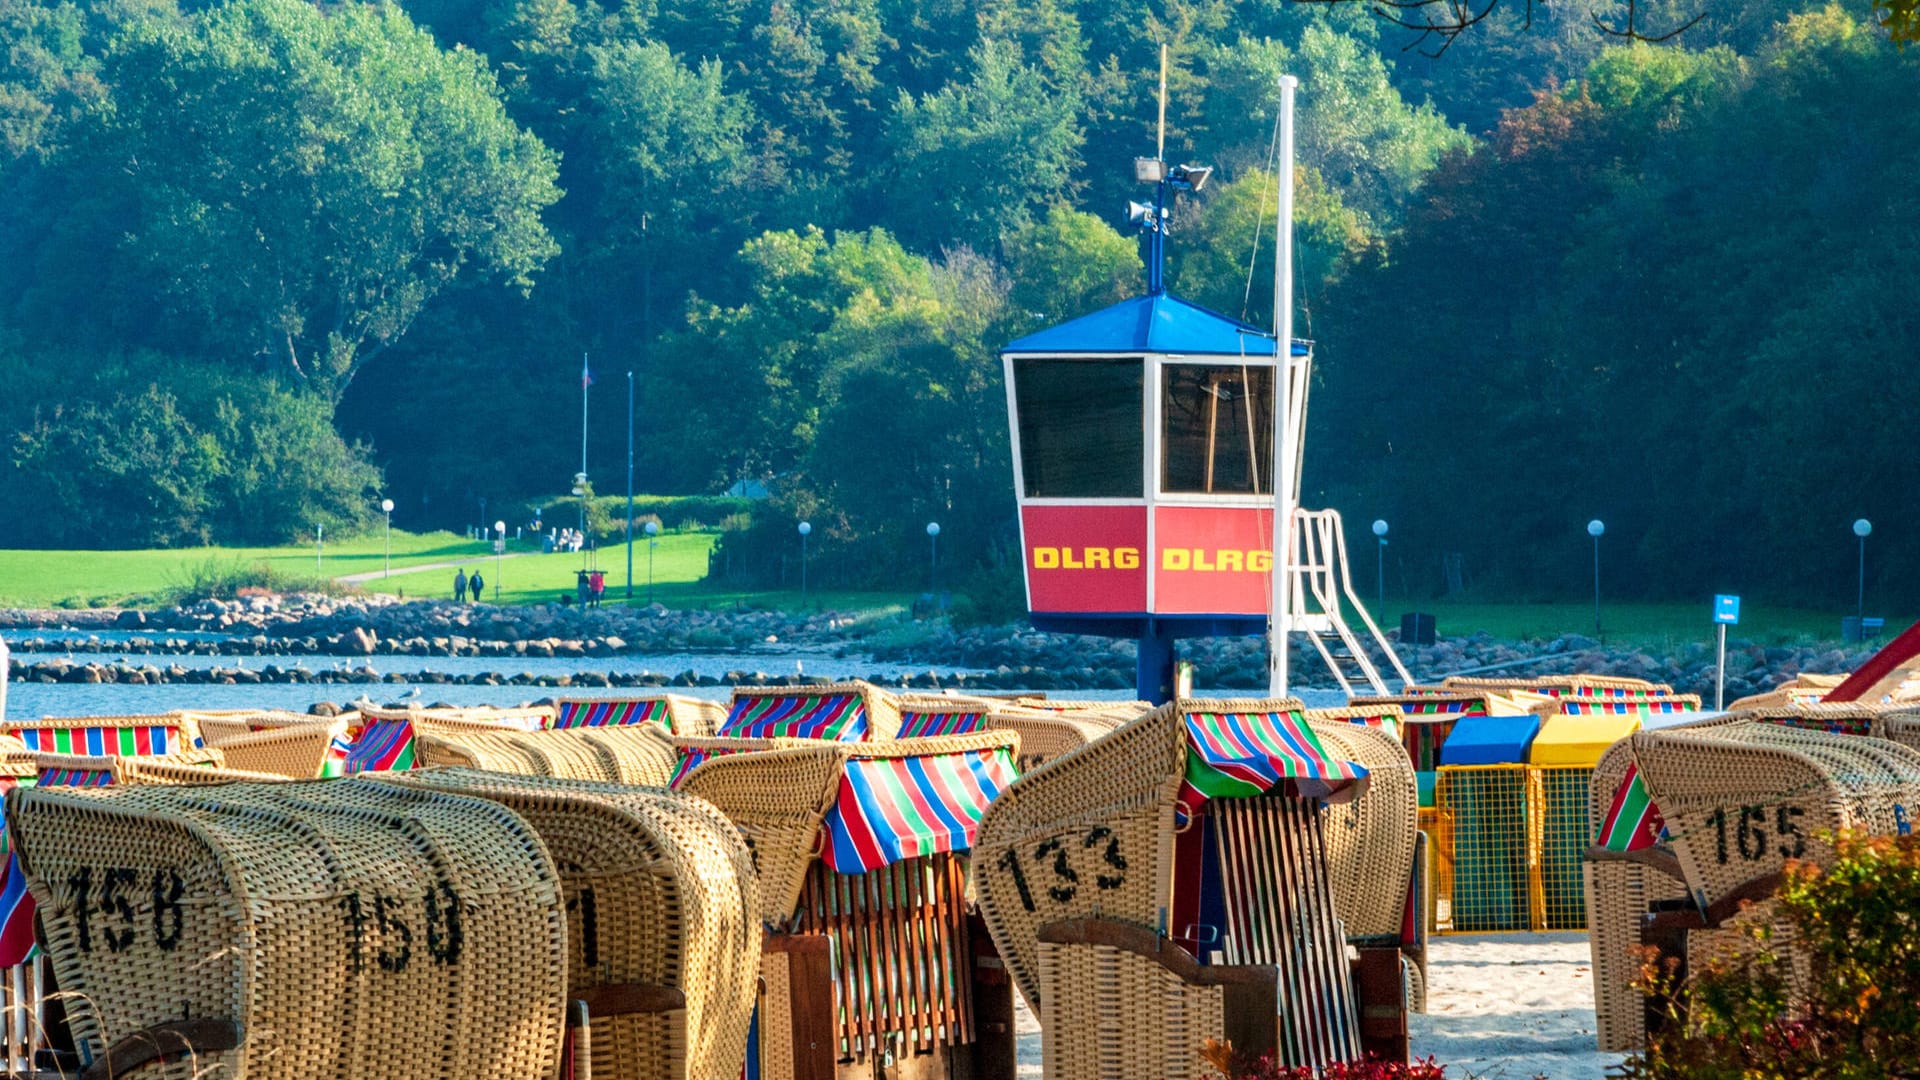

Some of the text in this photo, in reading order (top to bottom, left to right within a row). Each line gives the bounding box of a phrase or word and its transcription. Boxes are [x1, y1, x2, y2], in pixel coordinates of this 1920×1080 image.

[1033, 546, 1140, 570] DLRG
[1162, 547, 1274, 572] DLRG
[1705, 803, 1806, 865] 165
[997, 824, 1129, 913] 133
